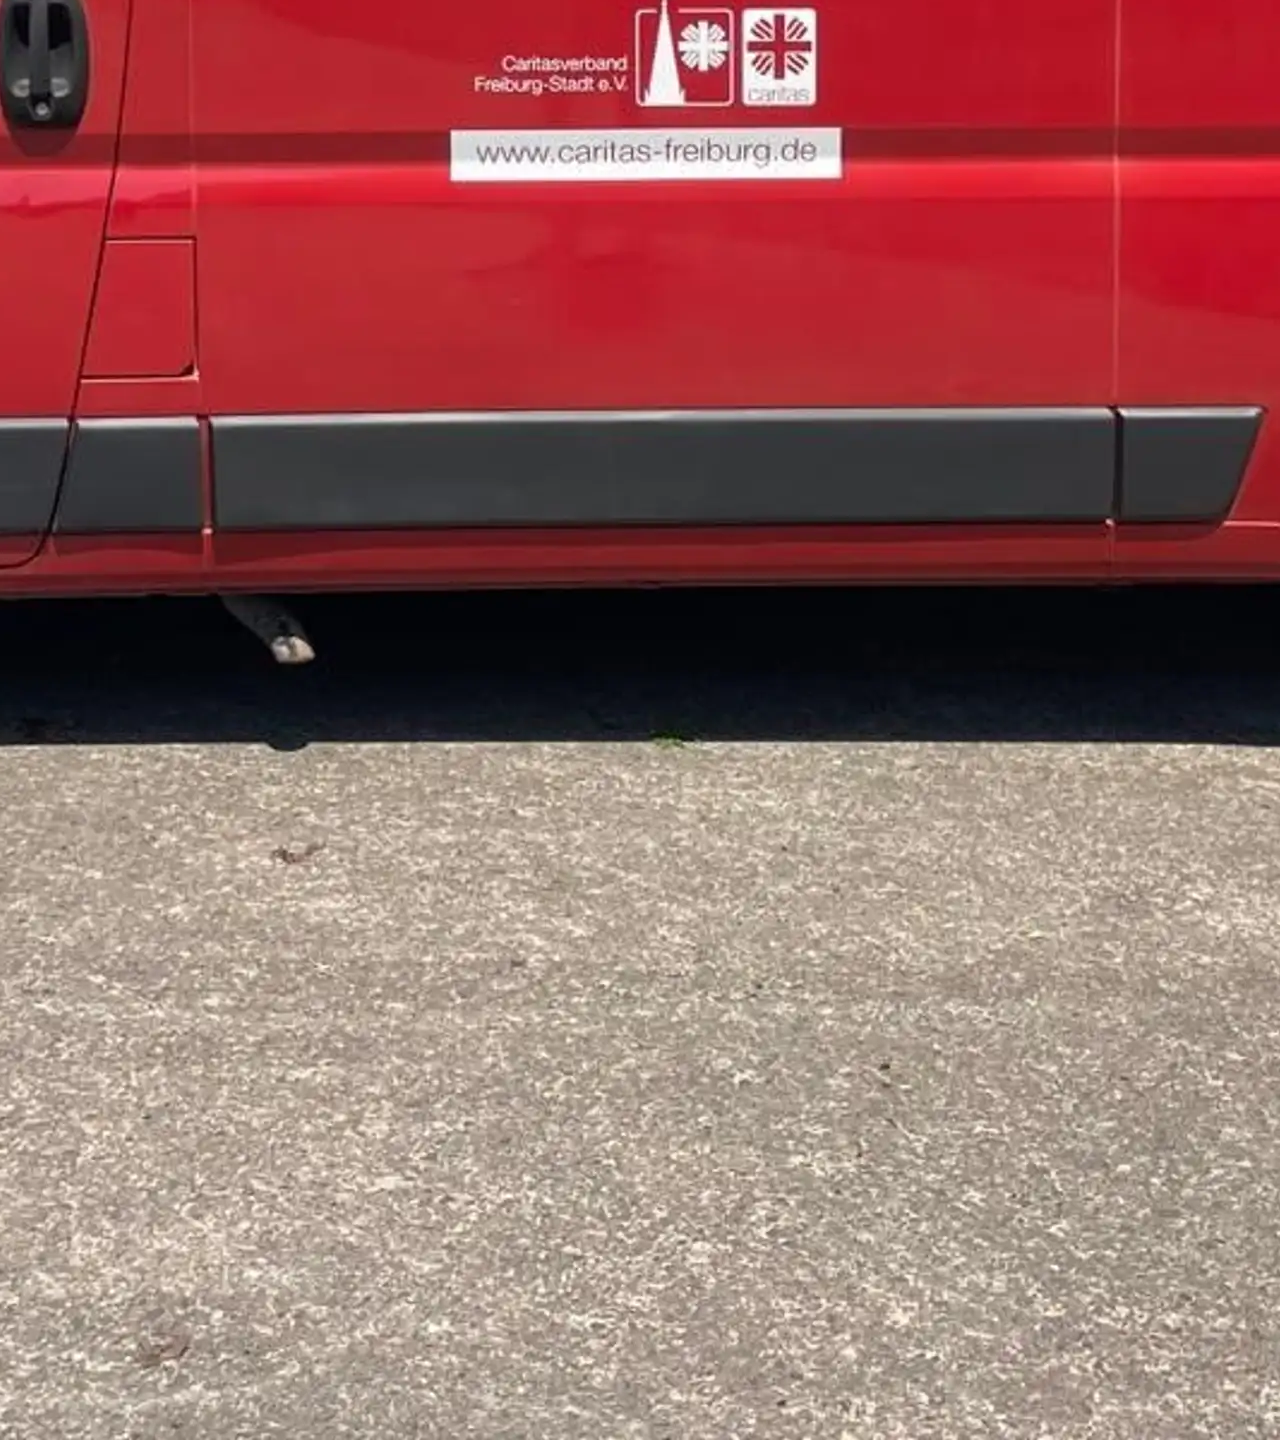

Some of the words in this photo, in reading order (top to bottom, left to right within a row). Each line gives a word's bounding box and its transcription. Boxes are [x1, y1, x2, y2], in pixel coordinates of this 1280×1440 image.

[502, 54, 629, 73] Caritasverband
[473, 75, 595, 97] Freiburg-Stadt
[598, 75, 629, 93] e.V.
[748, 86, 811, 102] caritas
[475, 137, 817, 168] www.caritas-freiburg.de
